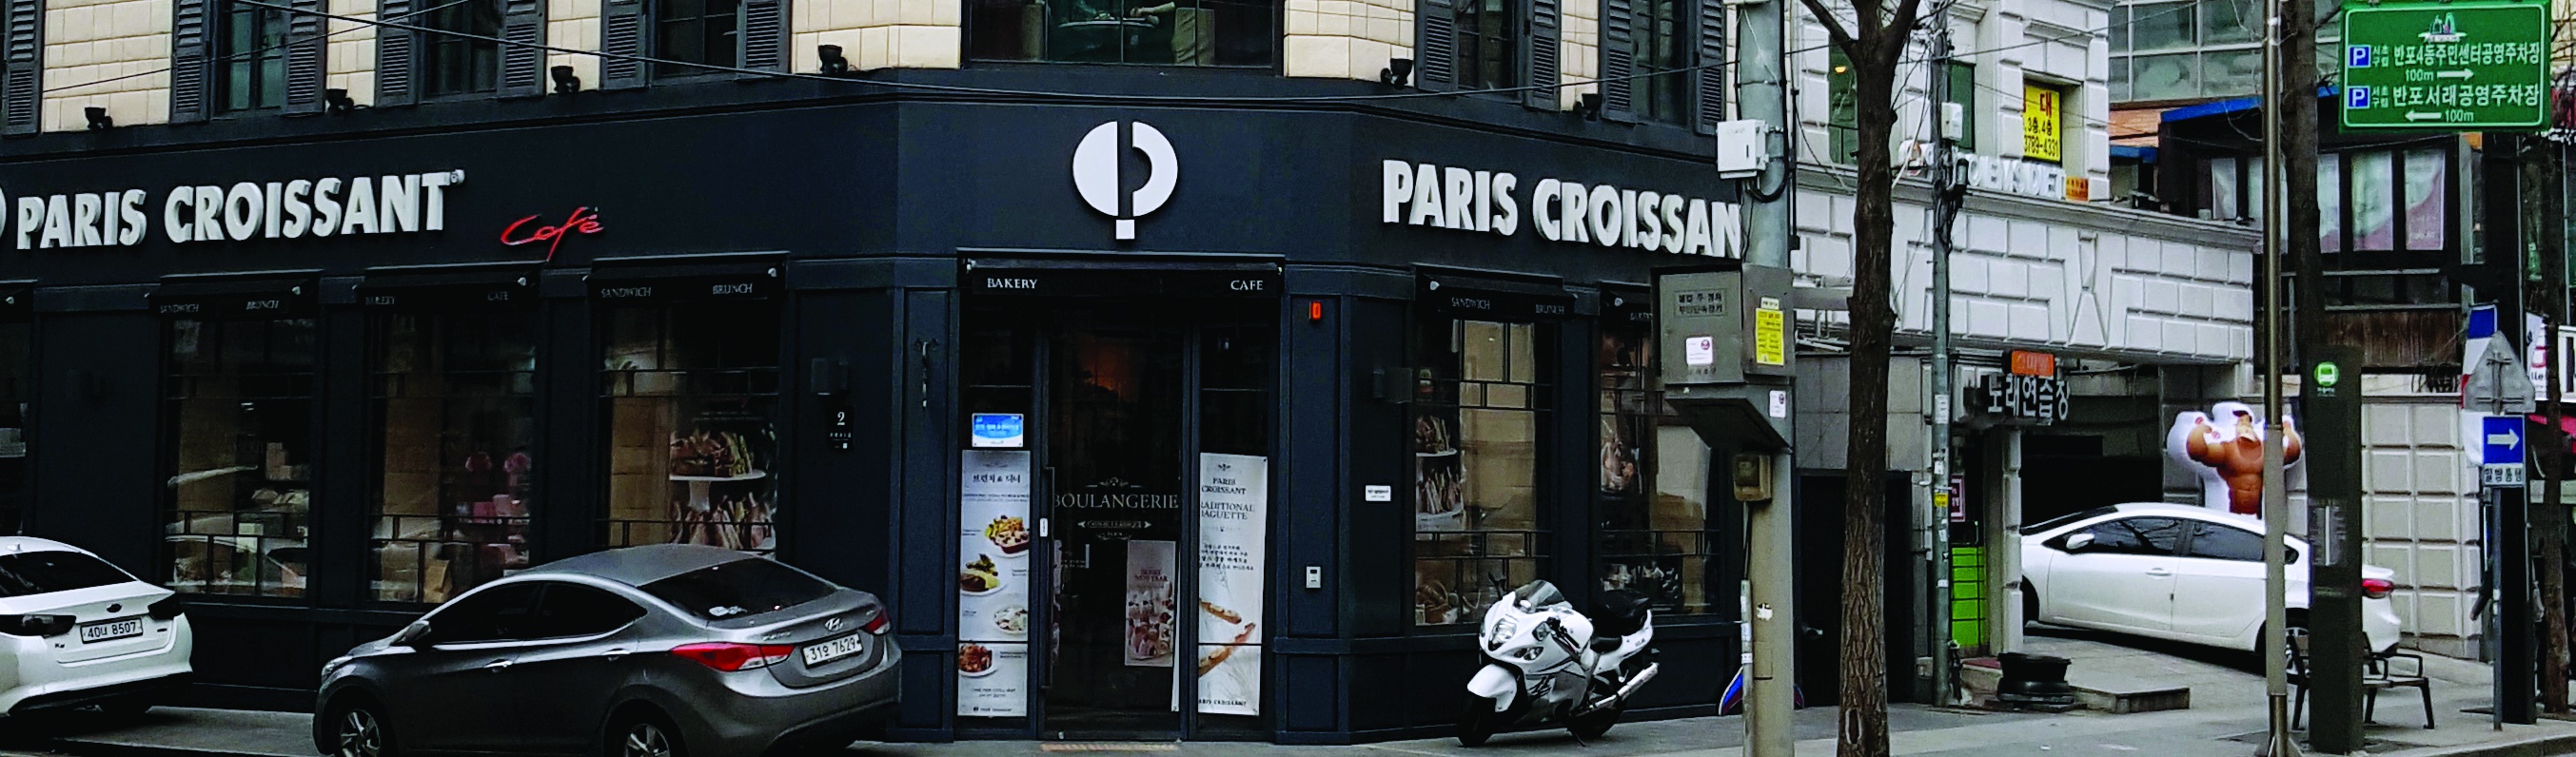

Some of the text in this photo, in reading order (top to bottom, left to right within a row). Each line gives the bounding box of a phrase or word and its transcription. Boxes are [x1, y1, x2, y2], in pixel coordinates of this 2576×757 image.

[2406, 68, 2434, 81] 100m
[2393, 83, 2540, 107] 반포서래공영주차장
[2445, 109, 2474, 123] 100m
[16, 170, 451, 249] PARIS CROISSANT
[1383, 159, 1740, 259] PARIS CROISSAN
[987, 277, 1264, 291] BAKERY CAFE
[600, 286, 652, 298] SANDWICH
[1987, 373, 2071, 420] 노래연습장
[836, 411, 845, 425] 2
[1212, 477, 1236, 486] PARIS
[1201, 485, 1247, 495] CROISSANT
[1053, 493, 1179, 509] BOULANGERIE
[111, 622, 137, 635] 8507
[832, 637, 855, 653] 7629
